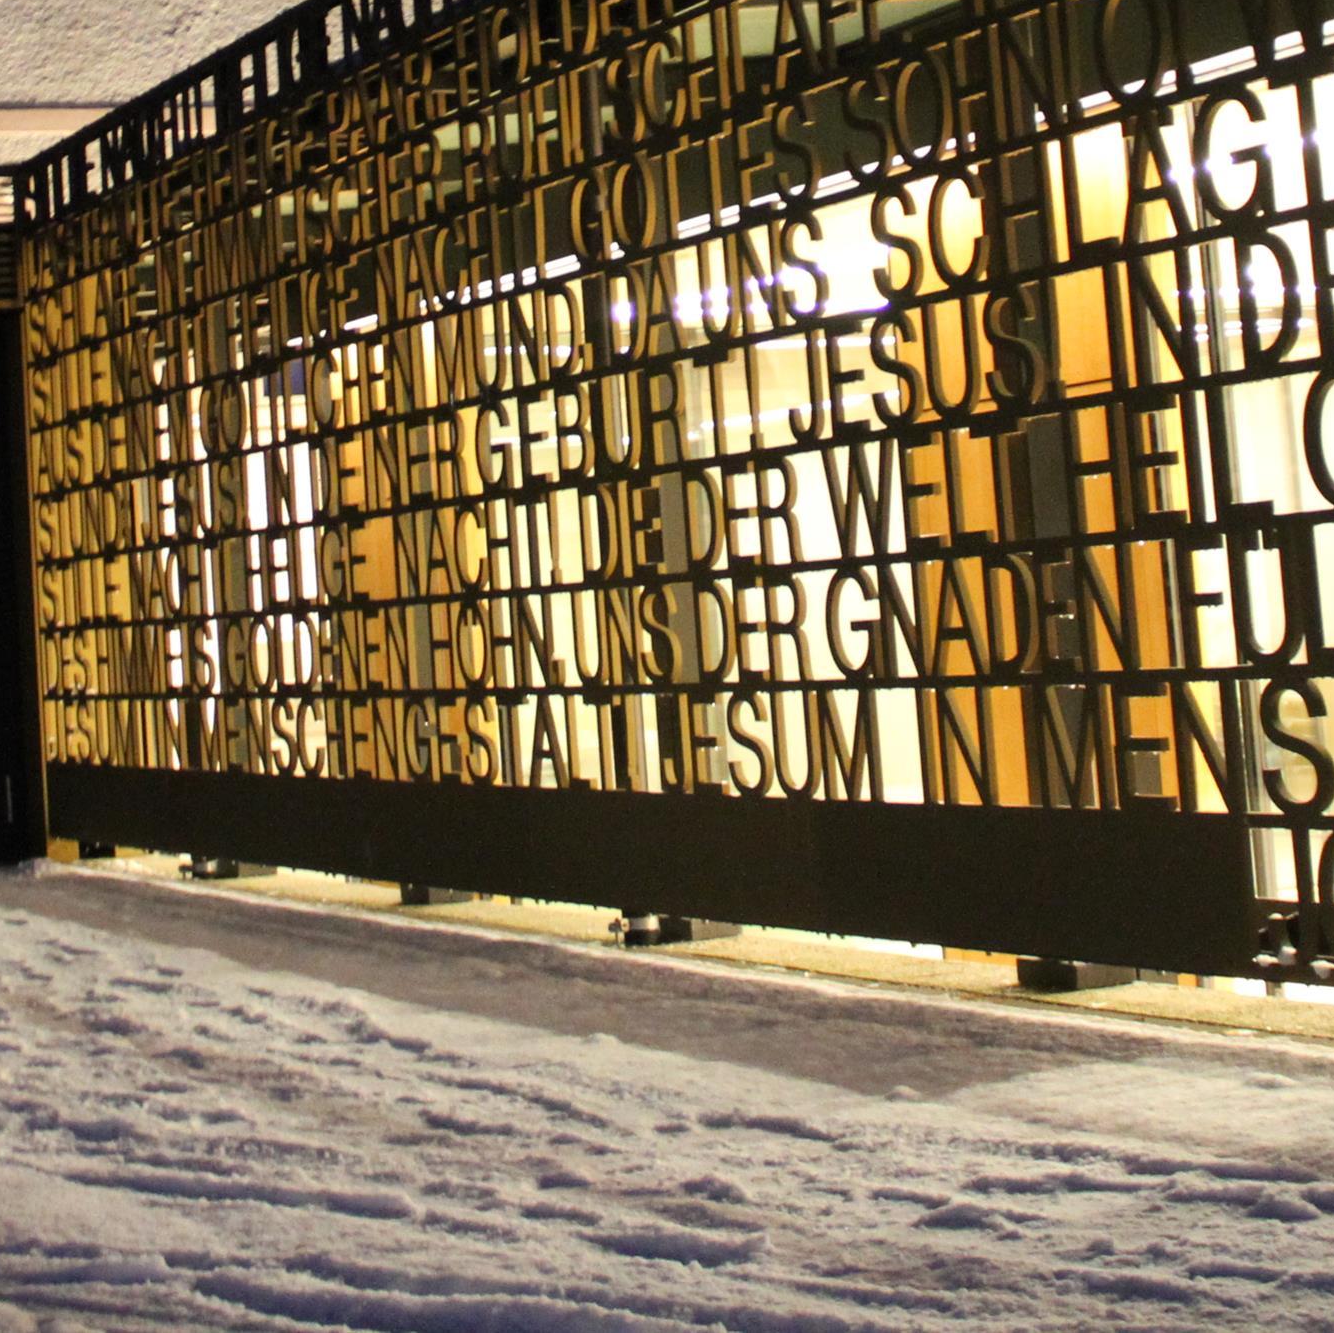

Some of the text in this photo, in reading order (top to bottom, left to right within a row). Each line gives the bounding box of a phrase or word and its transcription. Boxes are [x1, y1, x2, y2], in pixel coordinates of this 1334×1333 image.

[36, 416, 84, 499] AUS
[89, 385, 190, 486] DEINEM
[694, 201, 813, 347] UNS
[1102, 229, 1208, 392] IN
[40, 551, 121, 633] STILLE
[576, 464, 657, 581] DIE
[681, 441, 794, 571] DER
[822, 404, 1027, 558] WELT
[1064, 363, 1279, 535] HEIL
[44, 627, 88, 700] DES
[94, 614, 213, 698] HIMMELS
[223, 596, 409, 695] GOLDENEN
[570, 570, 675, 685] UNS
[690, 558, 801, 681] DER
[820, 526, 1135, 678] GNADEN
[44, 695, 135, 769] JESUM
[654, 673, 883, 796] JESUM
[915, 669, 998, 800] IN
